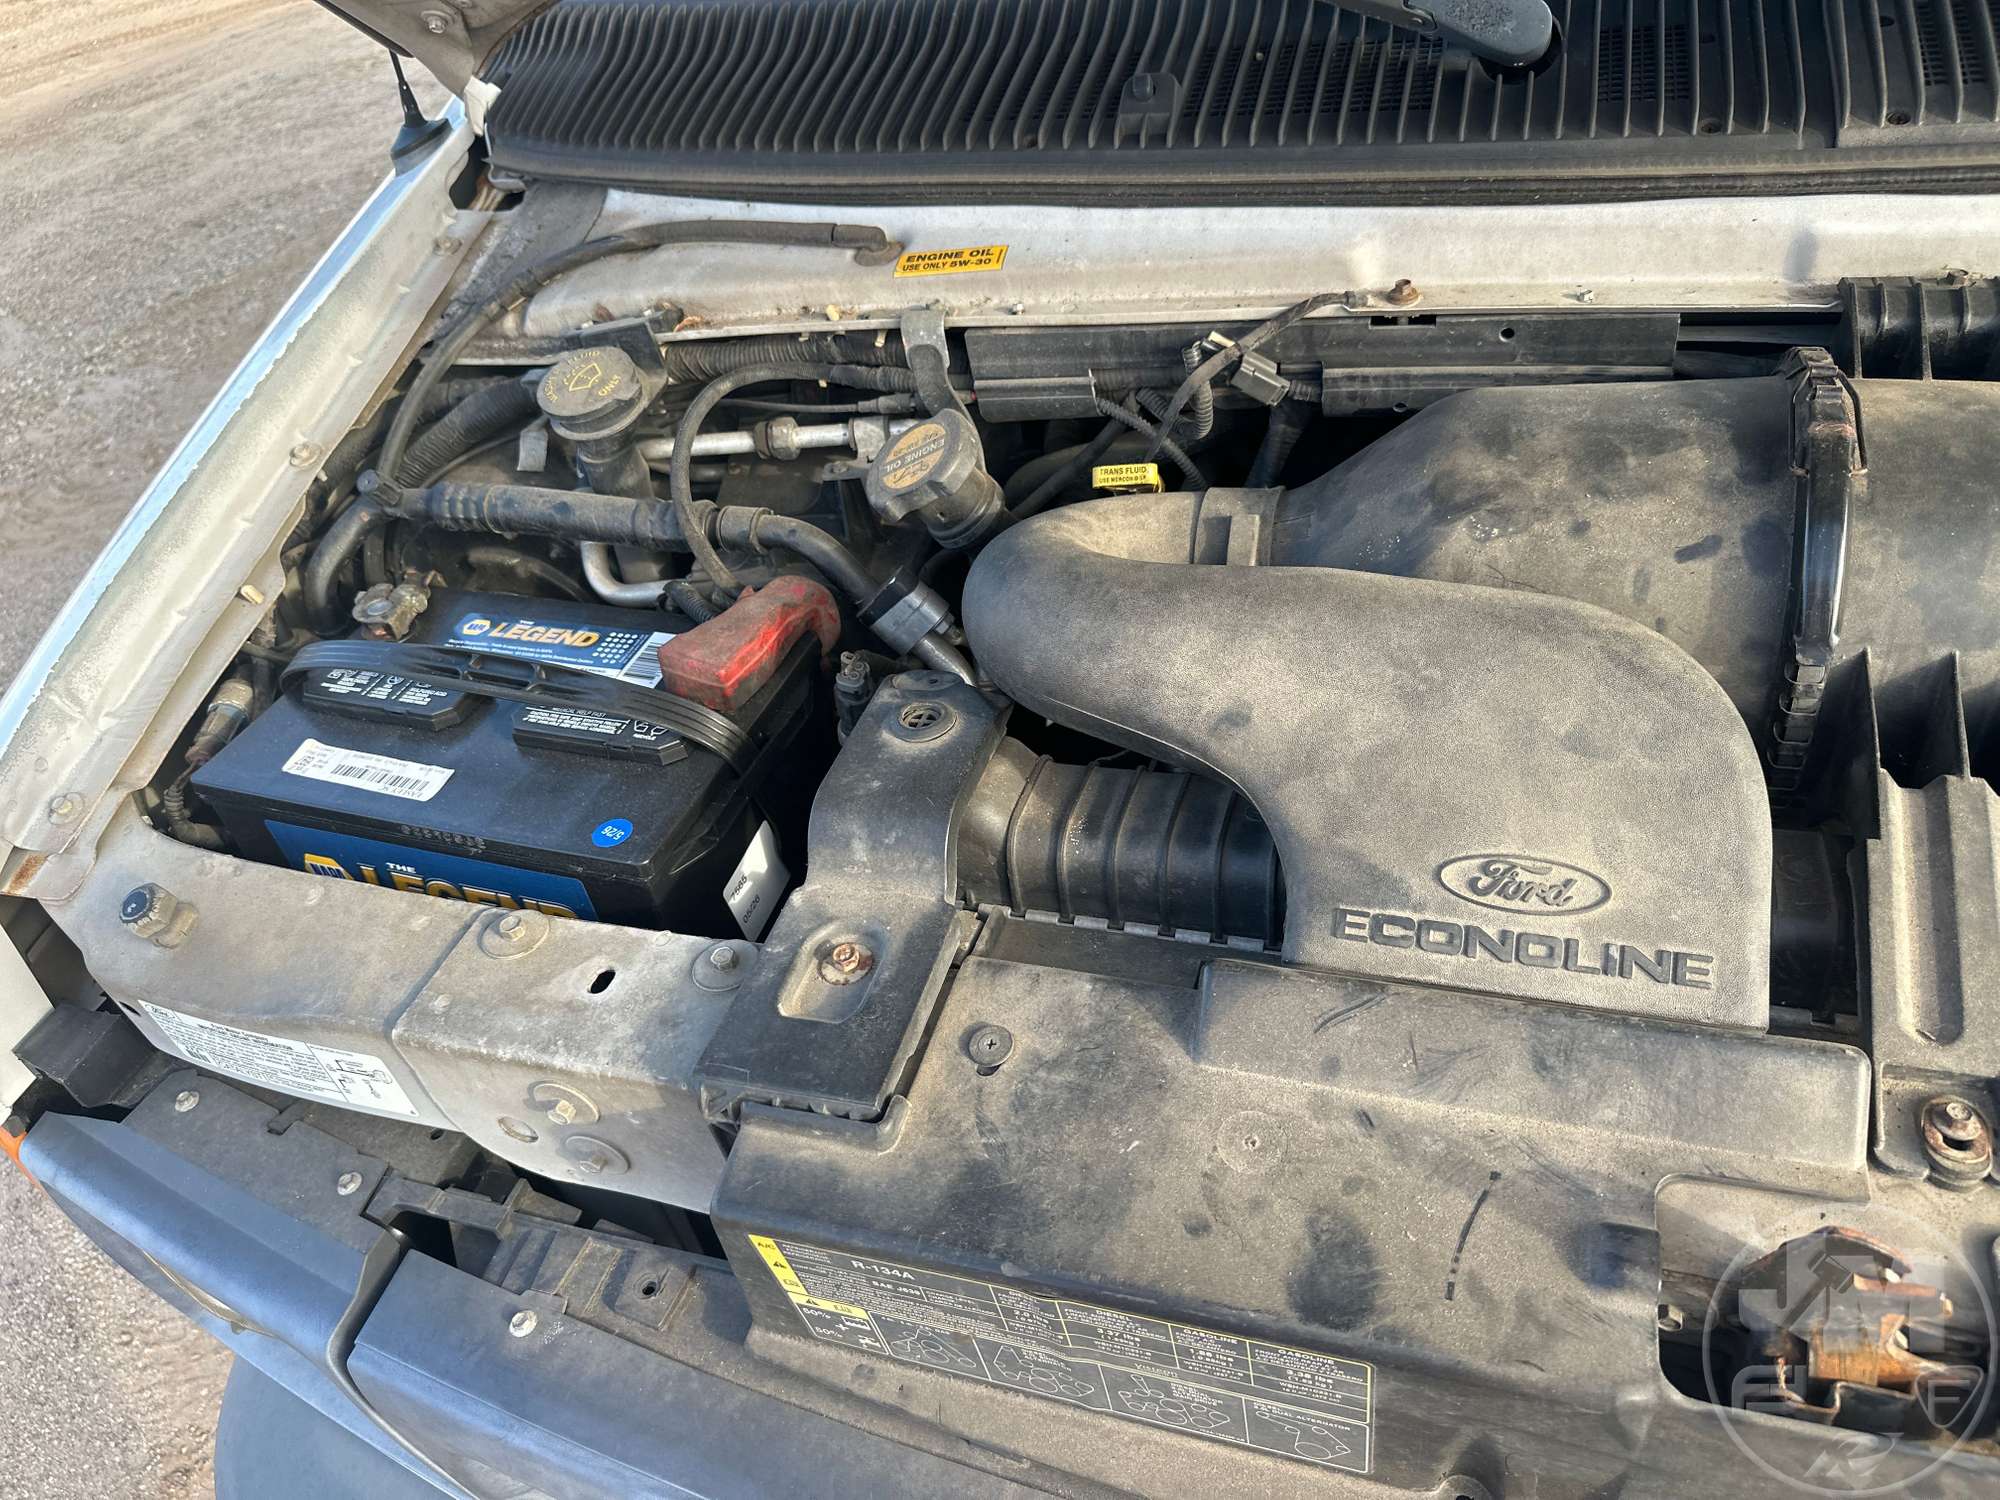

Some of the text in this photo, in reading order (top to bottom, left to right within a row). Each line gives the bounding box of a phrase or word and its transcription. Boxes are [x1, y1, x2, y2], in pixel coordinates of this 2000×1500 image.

[906, 248, 994, 263] ENGINE OIL
[902, 258, 992, 272] USE ONLY 5W-30
[599, 374, 621, 396] ONLY
[904, 439, 945, 465] ENGINE
[886, 460, 902, 473] OIL
[1100, 466, 1147, 476] TRANS FLUID
[488, 621, 600, 648] LEGEND
[601, 825, 624, 840] 5/26
[386, 862, 417, 874] THE
[1468, 858, 1578, 907] Ford
[1330, 907, 1714, 990] ECONOLINE
[850, 1259, 916, 1282] R-134A
[802, 1307, 832, 1320] 50%
[814, 1326, 844, 1339] 50%
[1183, 1328, 1238, 1344] GASOLINE
[1277, 1348, 1335, 1366] GASOLINE
